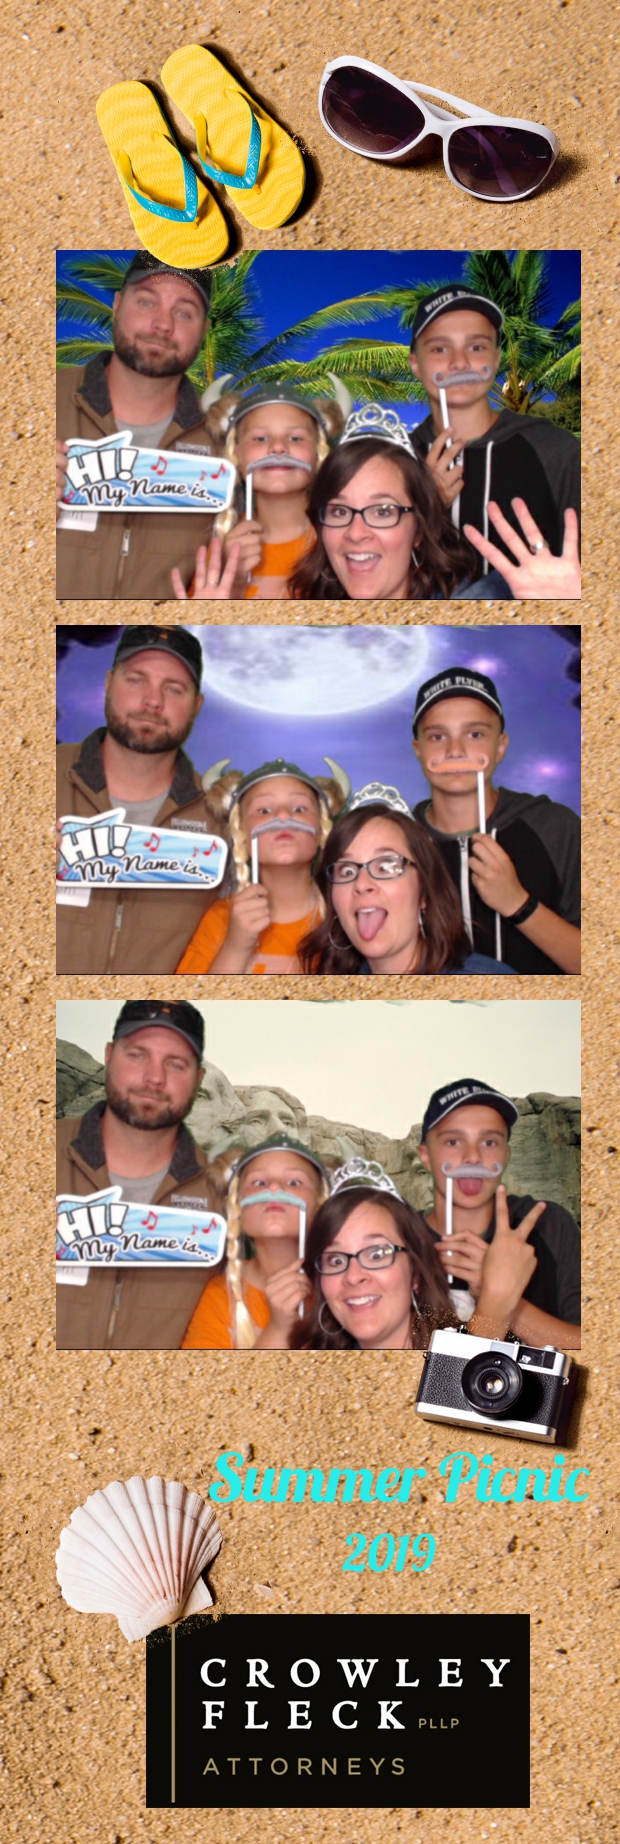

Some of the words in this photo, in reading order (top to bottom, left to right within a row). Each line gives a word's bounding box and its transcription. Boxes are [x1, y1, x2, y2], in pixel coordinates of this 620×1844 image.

[424, 292, 454, 313] WHITE
[66, 448, 139, 490] HI!
[82, 483, 126, 507] My
[130, 478, 187, 496] Name
[423, 678, 452, 700] WHITE
[59, 824, 132, 867] HI!
[75, 860, 119, 883] My
[123, 855, 180, 872] Name
[439, 1086, 470, 1105] WHITE
[56, 1202, 129, 1246] HI!
[72, 1239, 116, 1262] My
[120, 1234, 177, 1251] Name
